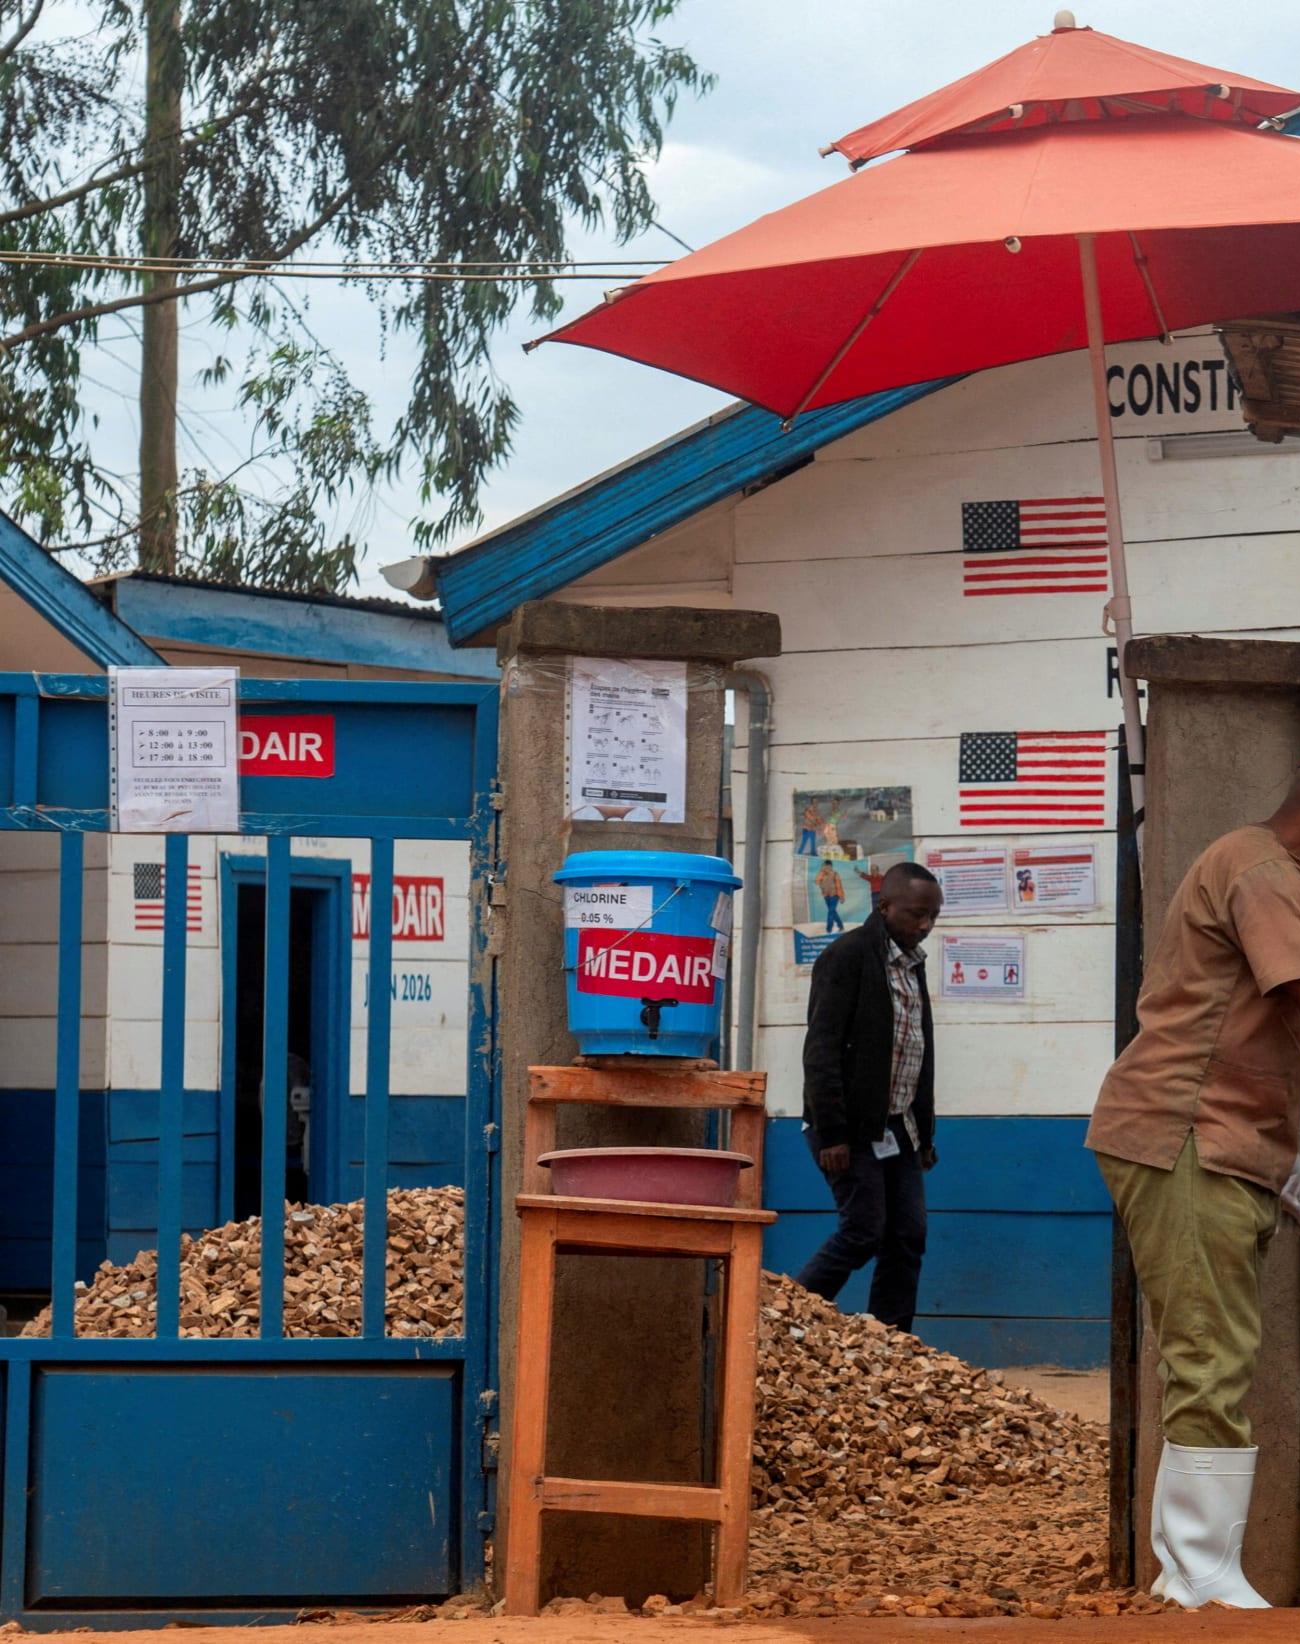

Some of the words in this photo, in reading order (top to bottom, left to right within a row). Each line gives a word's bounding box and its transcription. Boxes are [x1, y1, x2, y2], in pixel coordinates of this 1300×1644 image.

[190, 691, 221, 699] VISITE
[574, 892, 627, 904] CHLORINE
[353, 882, 443, 937] MDAIR
[581, 913, 600, 923] 0.05
[603, 914, 613, 923] %
[584, 946, 711, 987] MEDAIR
[402, 974, 432, 1001] 2026
